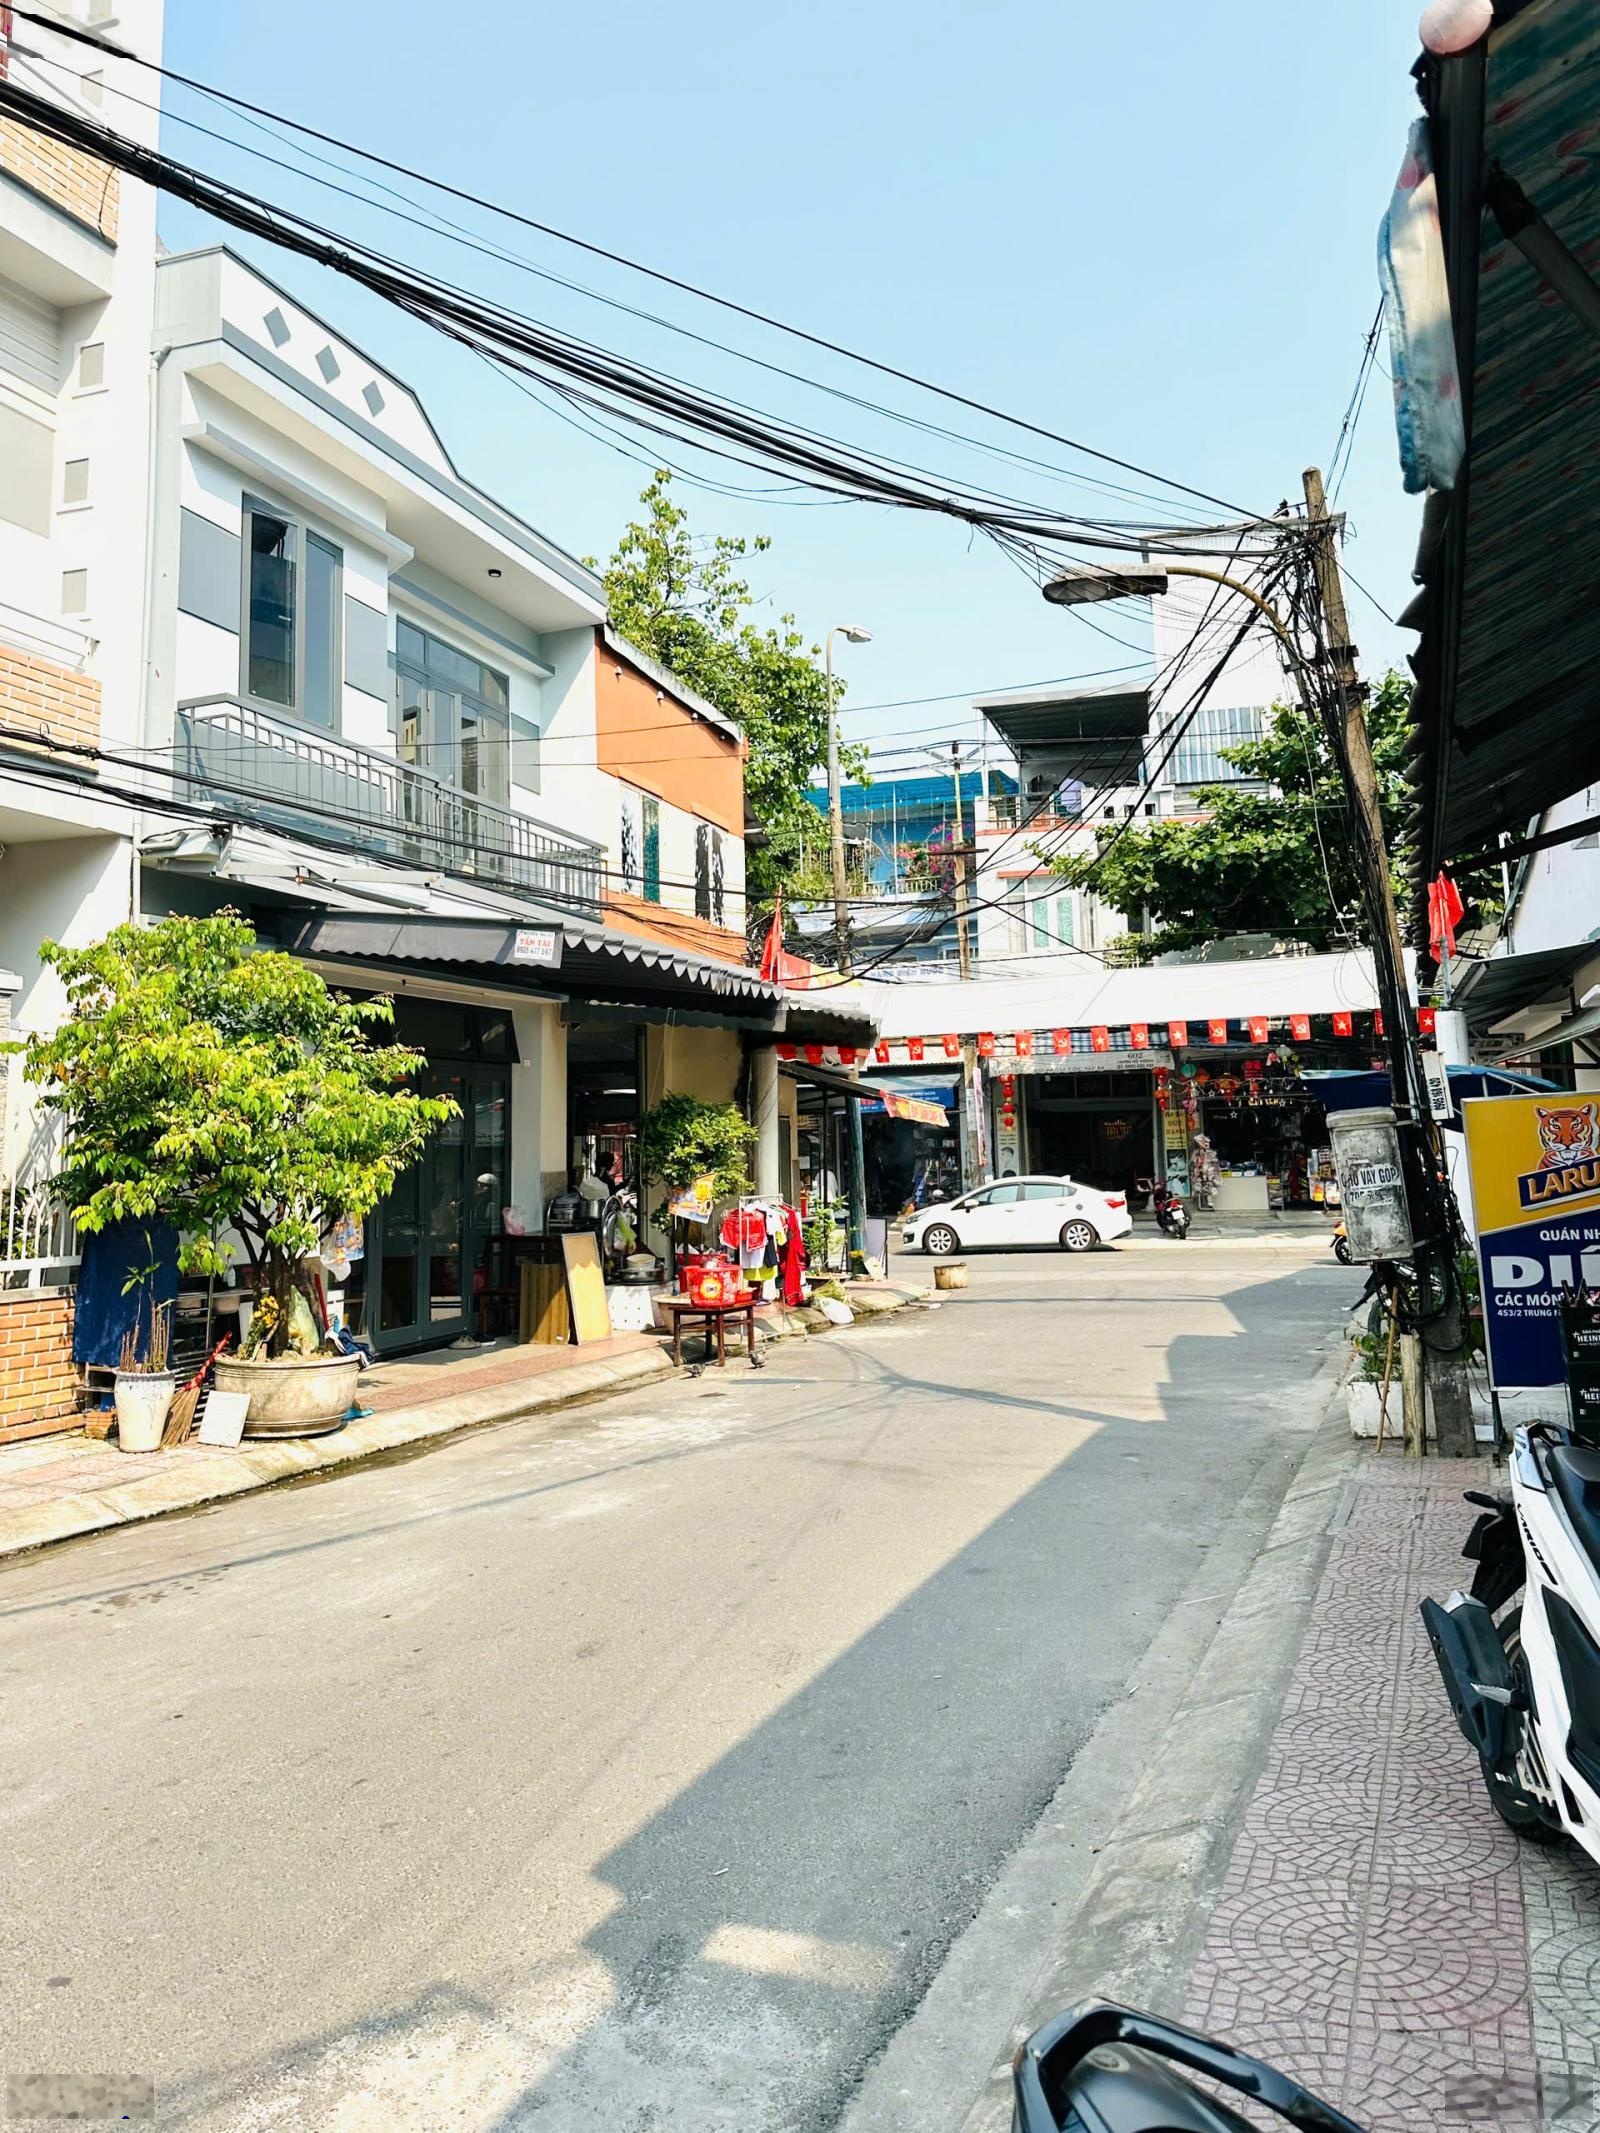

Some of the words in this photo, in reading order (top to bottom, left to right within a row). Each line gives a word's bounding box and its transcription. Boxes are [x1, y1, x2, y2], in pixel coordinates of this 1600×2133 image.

[1360, 1169, 1376, 1185] VAY
[1540, 1227, 1581, 1241] QUÁN
[1495, 1291, 1522, 1306] CÁC
[1497, 1309, 1522, 1317] 453/2
